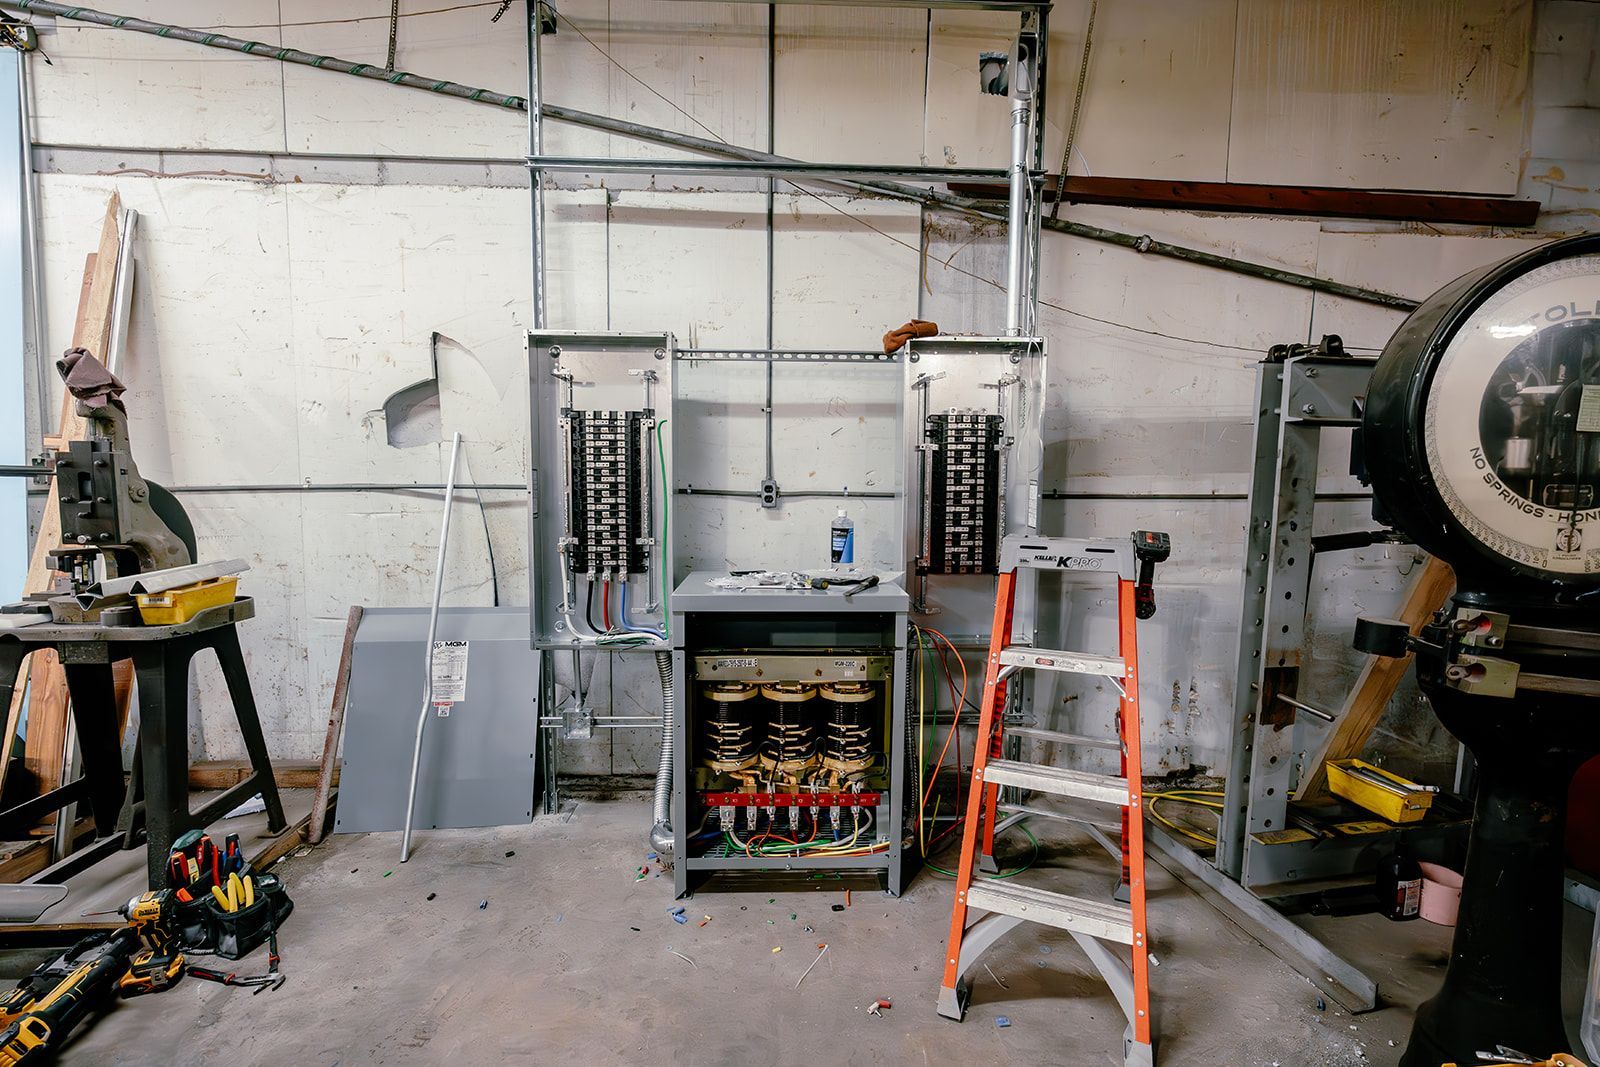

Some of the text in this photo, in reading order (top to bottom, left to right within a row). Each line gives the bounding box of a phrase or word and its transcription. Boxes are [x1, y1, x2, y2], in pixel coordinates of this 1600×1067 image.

[1469, 447, 1486, 470] NO
[1482, 472, 1545, 518] SPRINGS
[1557, 511, 1600, 523] HON
